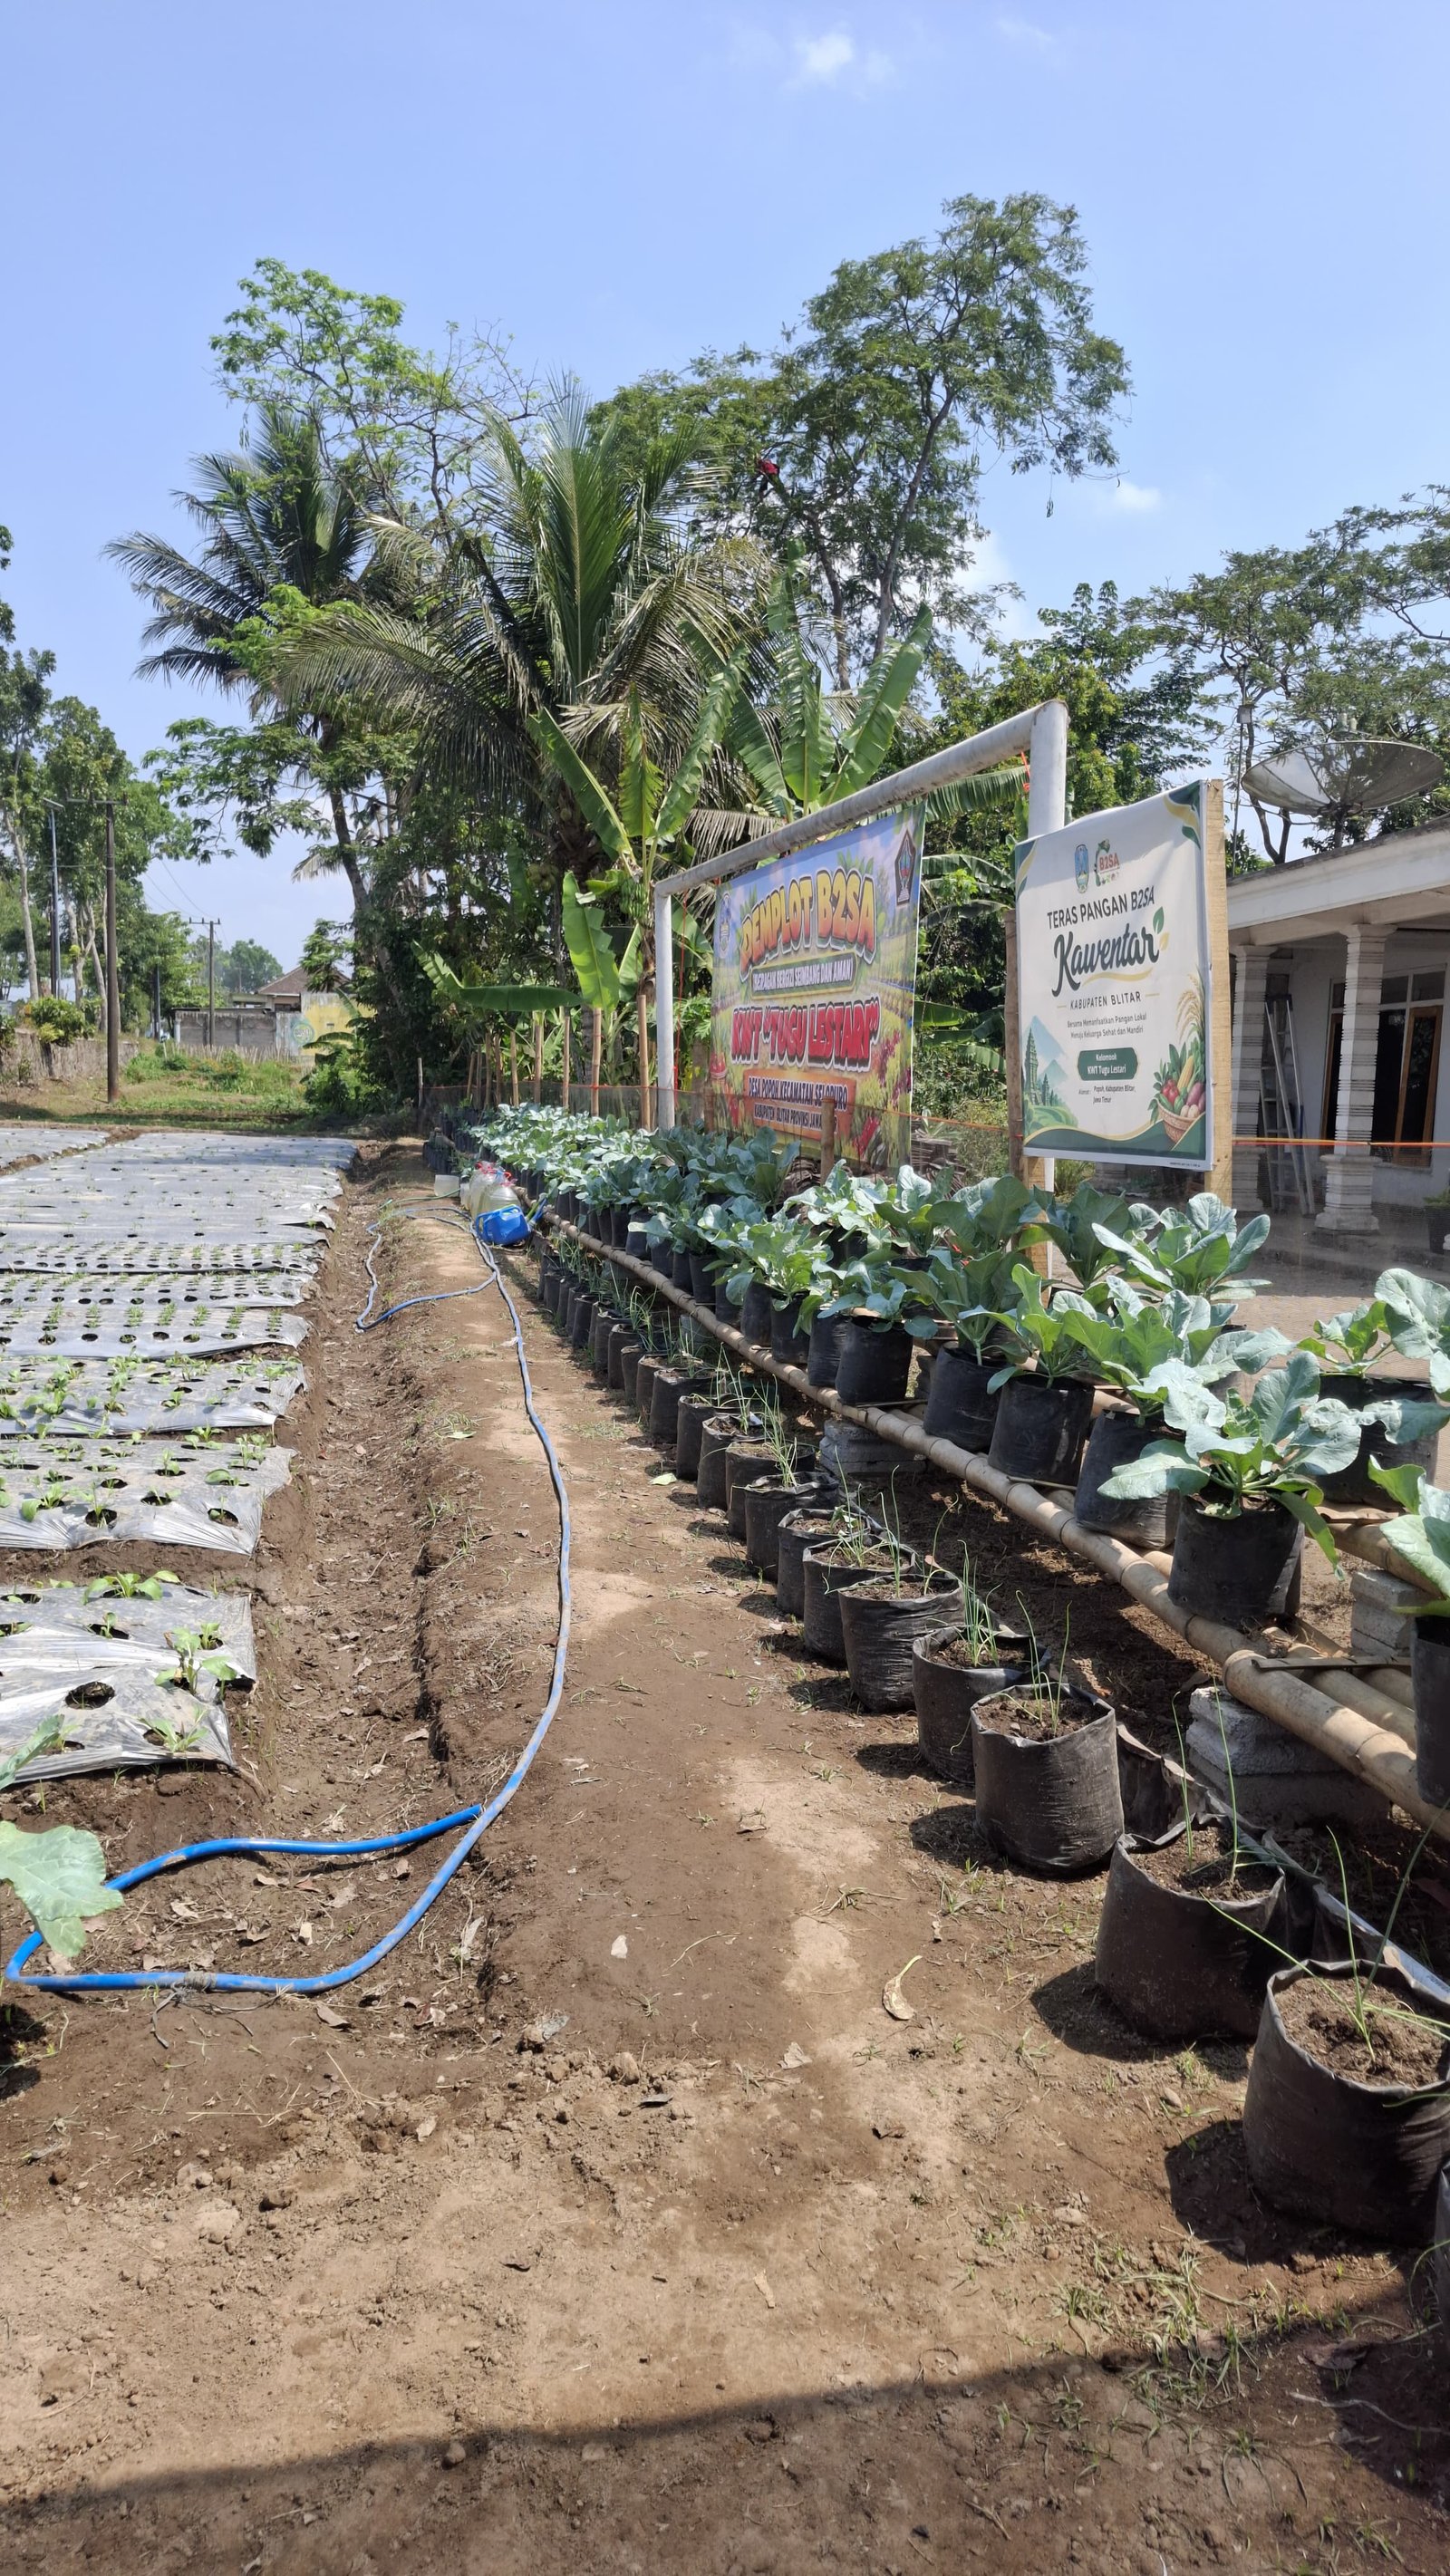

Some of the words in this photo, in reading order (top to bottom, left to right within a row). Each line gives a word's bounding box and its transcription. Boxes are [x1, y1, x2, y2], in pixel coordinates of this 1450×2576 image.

[1099, 853, 1120, 871] B2SA
[816, 865, 876, 964] B2SA
[1047, 906, 1078, 930] TERAS
[1079, 893, 1128, 922] PANGAN
[1130, 885, 1155, 912] B2SA
[1051, 922, 1160, 998] Kawentar
[820, 961, 833, 983] DAN
[1070, 996, 1107, 1010] KABUPATEN
[1110, 991, 1142, 1006] BLITAR
[1115, 1015, 1134, 1025] Pangan
[1134, 1012, 1147, 1021] Lokal
[731, 1007, 763, 1065] KWT
[1102, 1028, 1116, 1037] Sehat
[1116, 1028, 1126, 1036] dan
[1126, 1026, 1144, 1034] Mandiri
[1088, 1065, 1098, 1075] KWT
[1098, 1065, 1110, 1076] Tugu
[1110, 1064, 1126, 1074] Lestari
[748, 1076, 761, 1098] DESA
[779, 1080, 814, 1105] KECAMATAN
